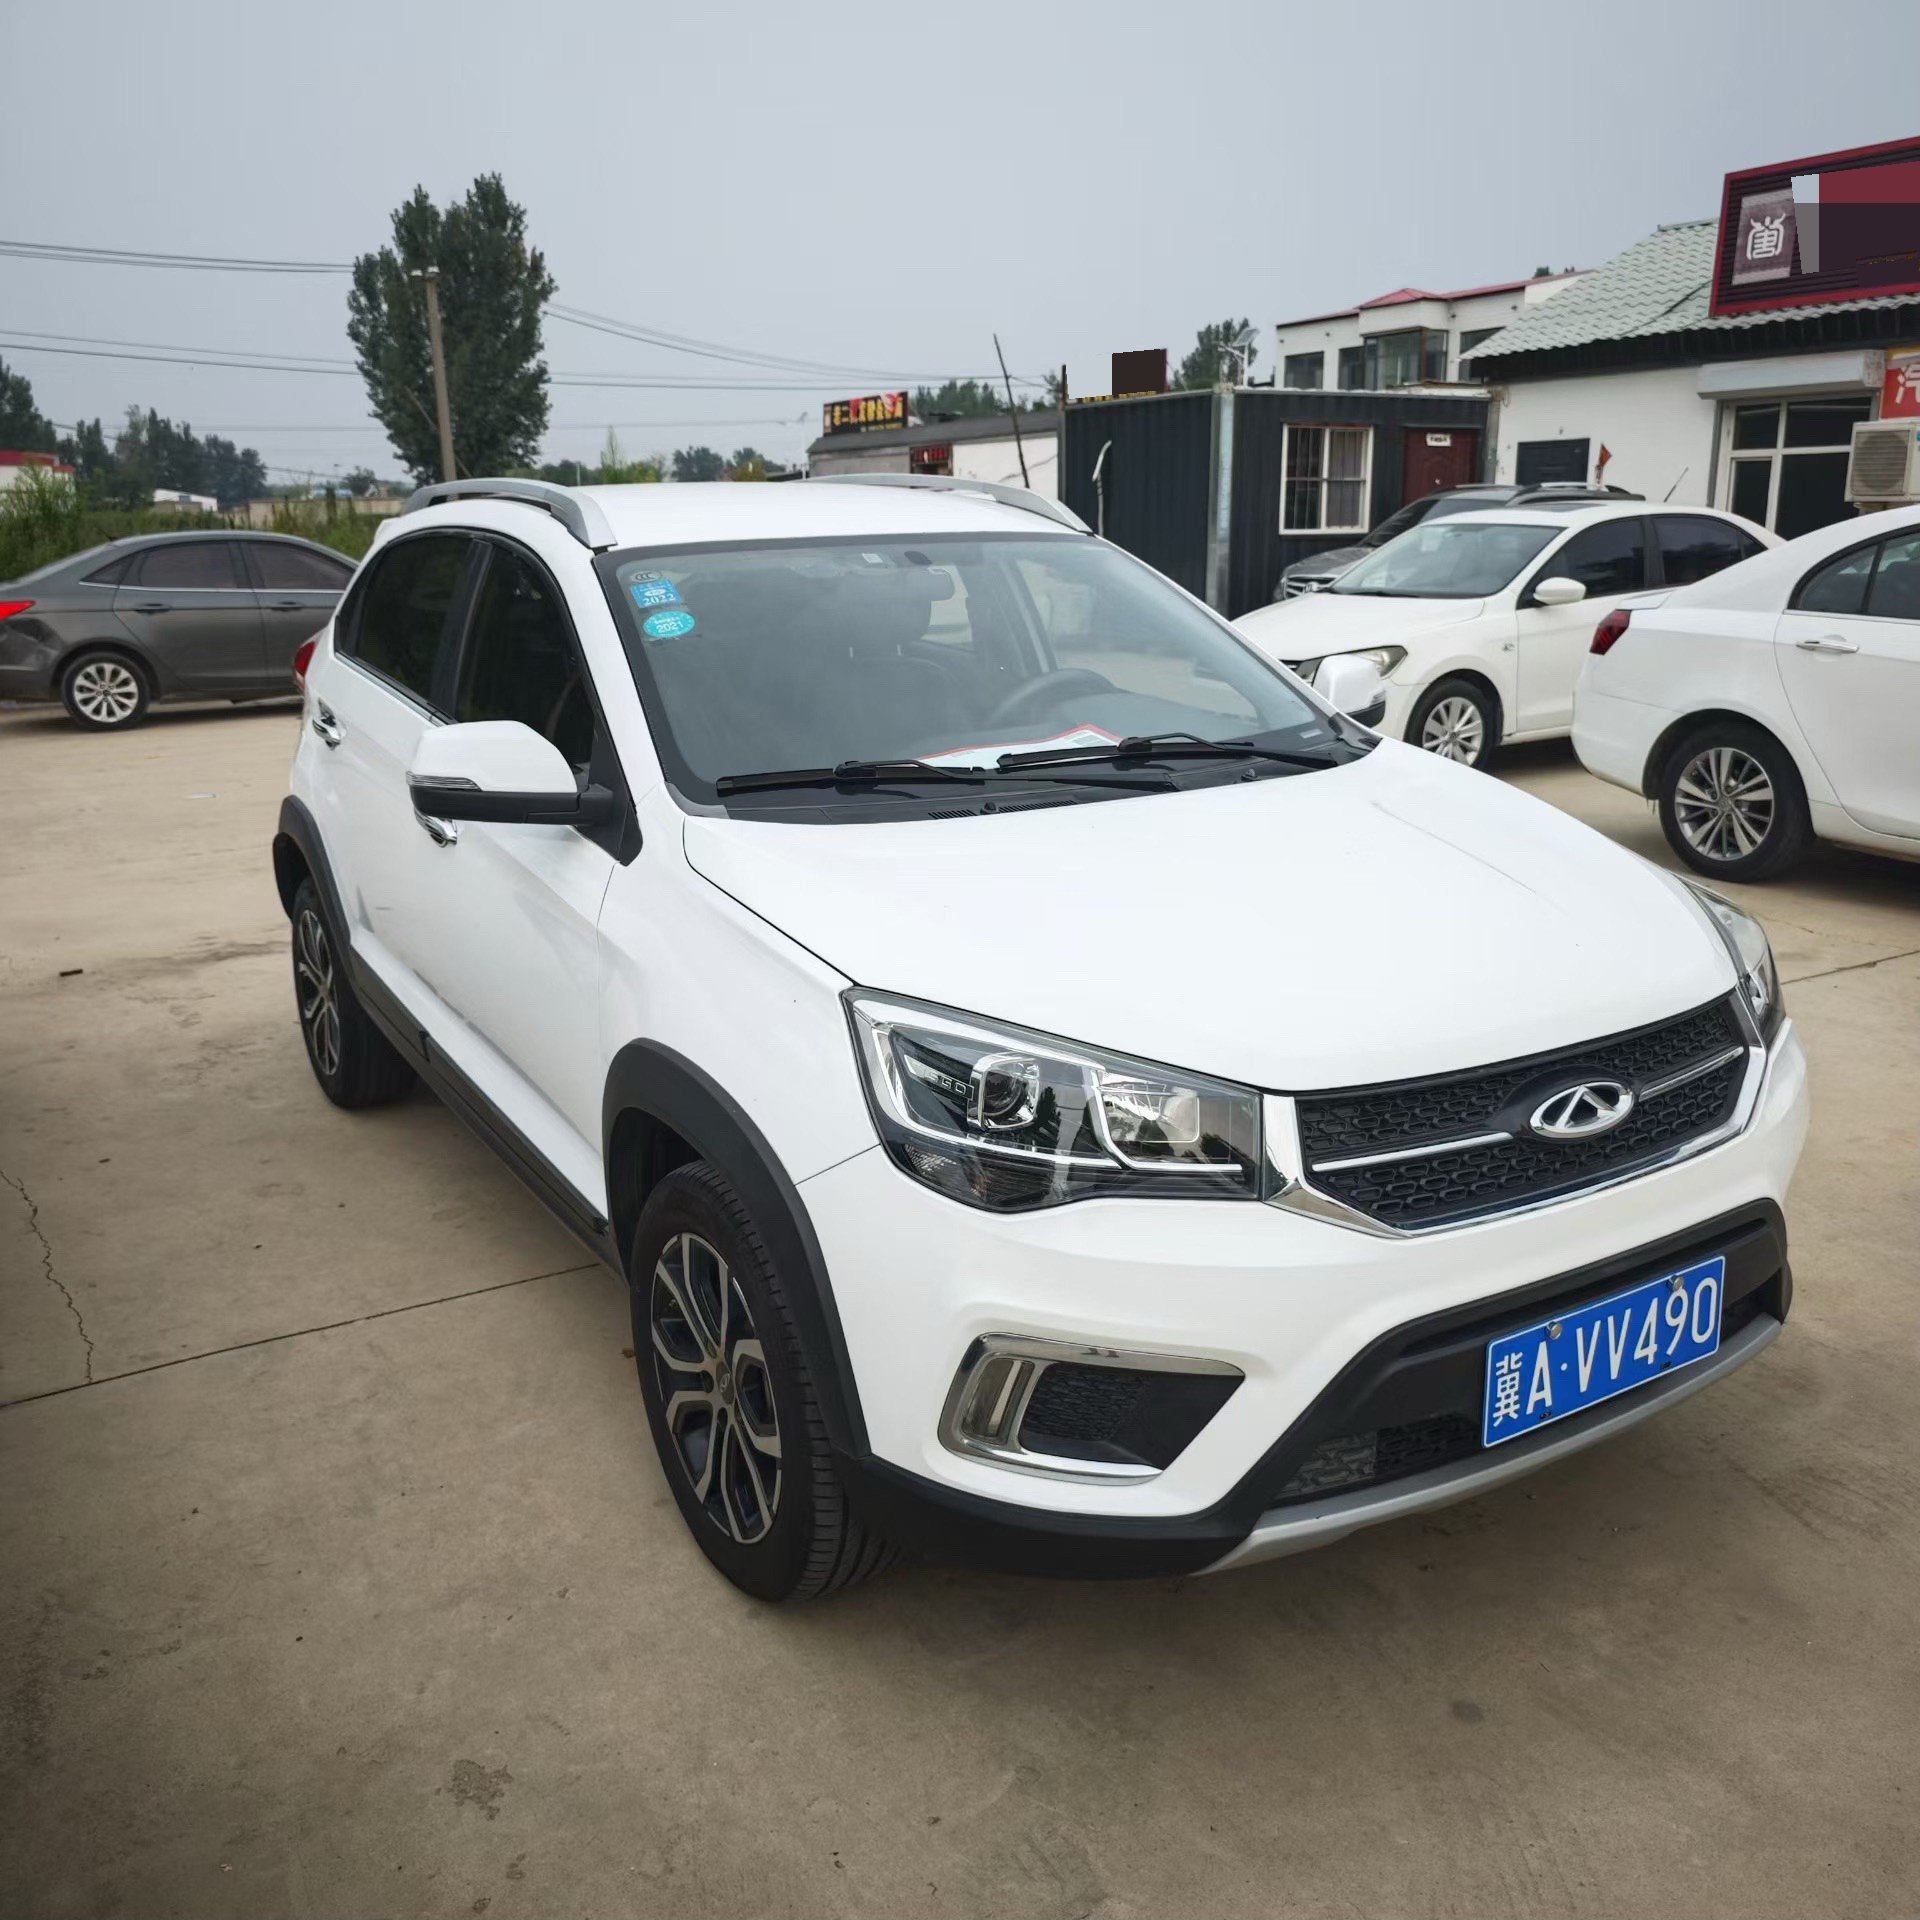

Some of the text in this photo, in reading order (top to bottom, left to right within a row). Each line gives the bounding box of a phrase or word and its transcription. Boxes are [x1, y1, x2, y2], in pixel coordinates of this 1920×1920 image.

[643, 593, 676, 606] 2022
[656, 620, 684, 633] 2021
[1493, 1277, 1718, 1427] 冀A·VV490
